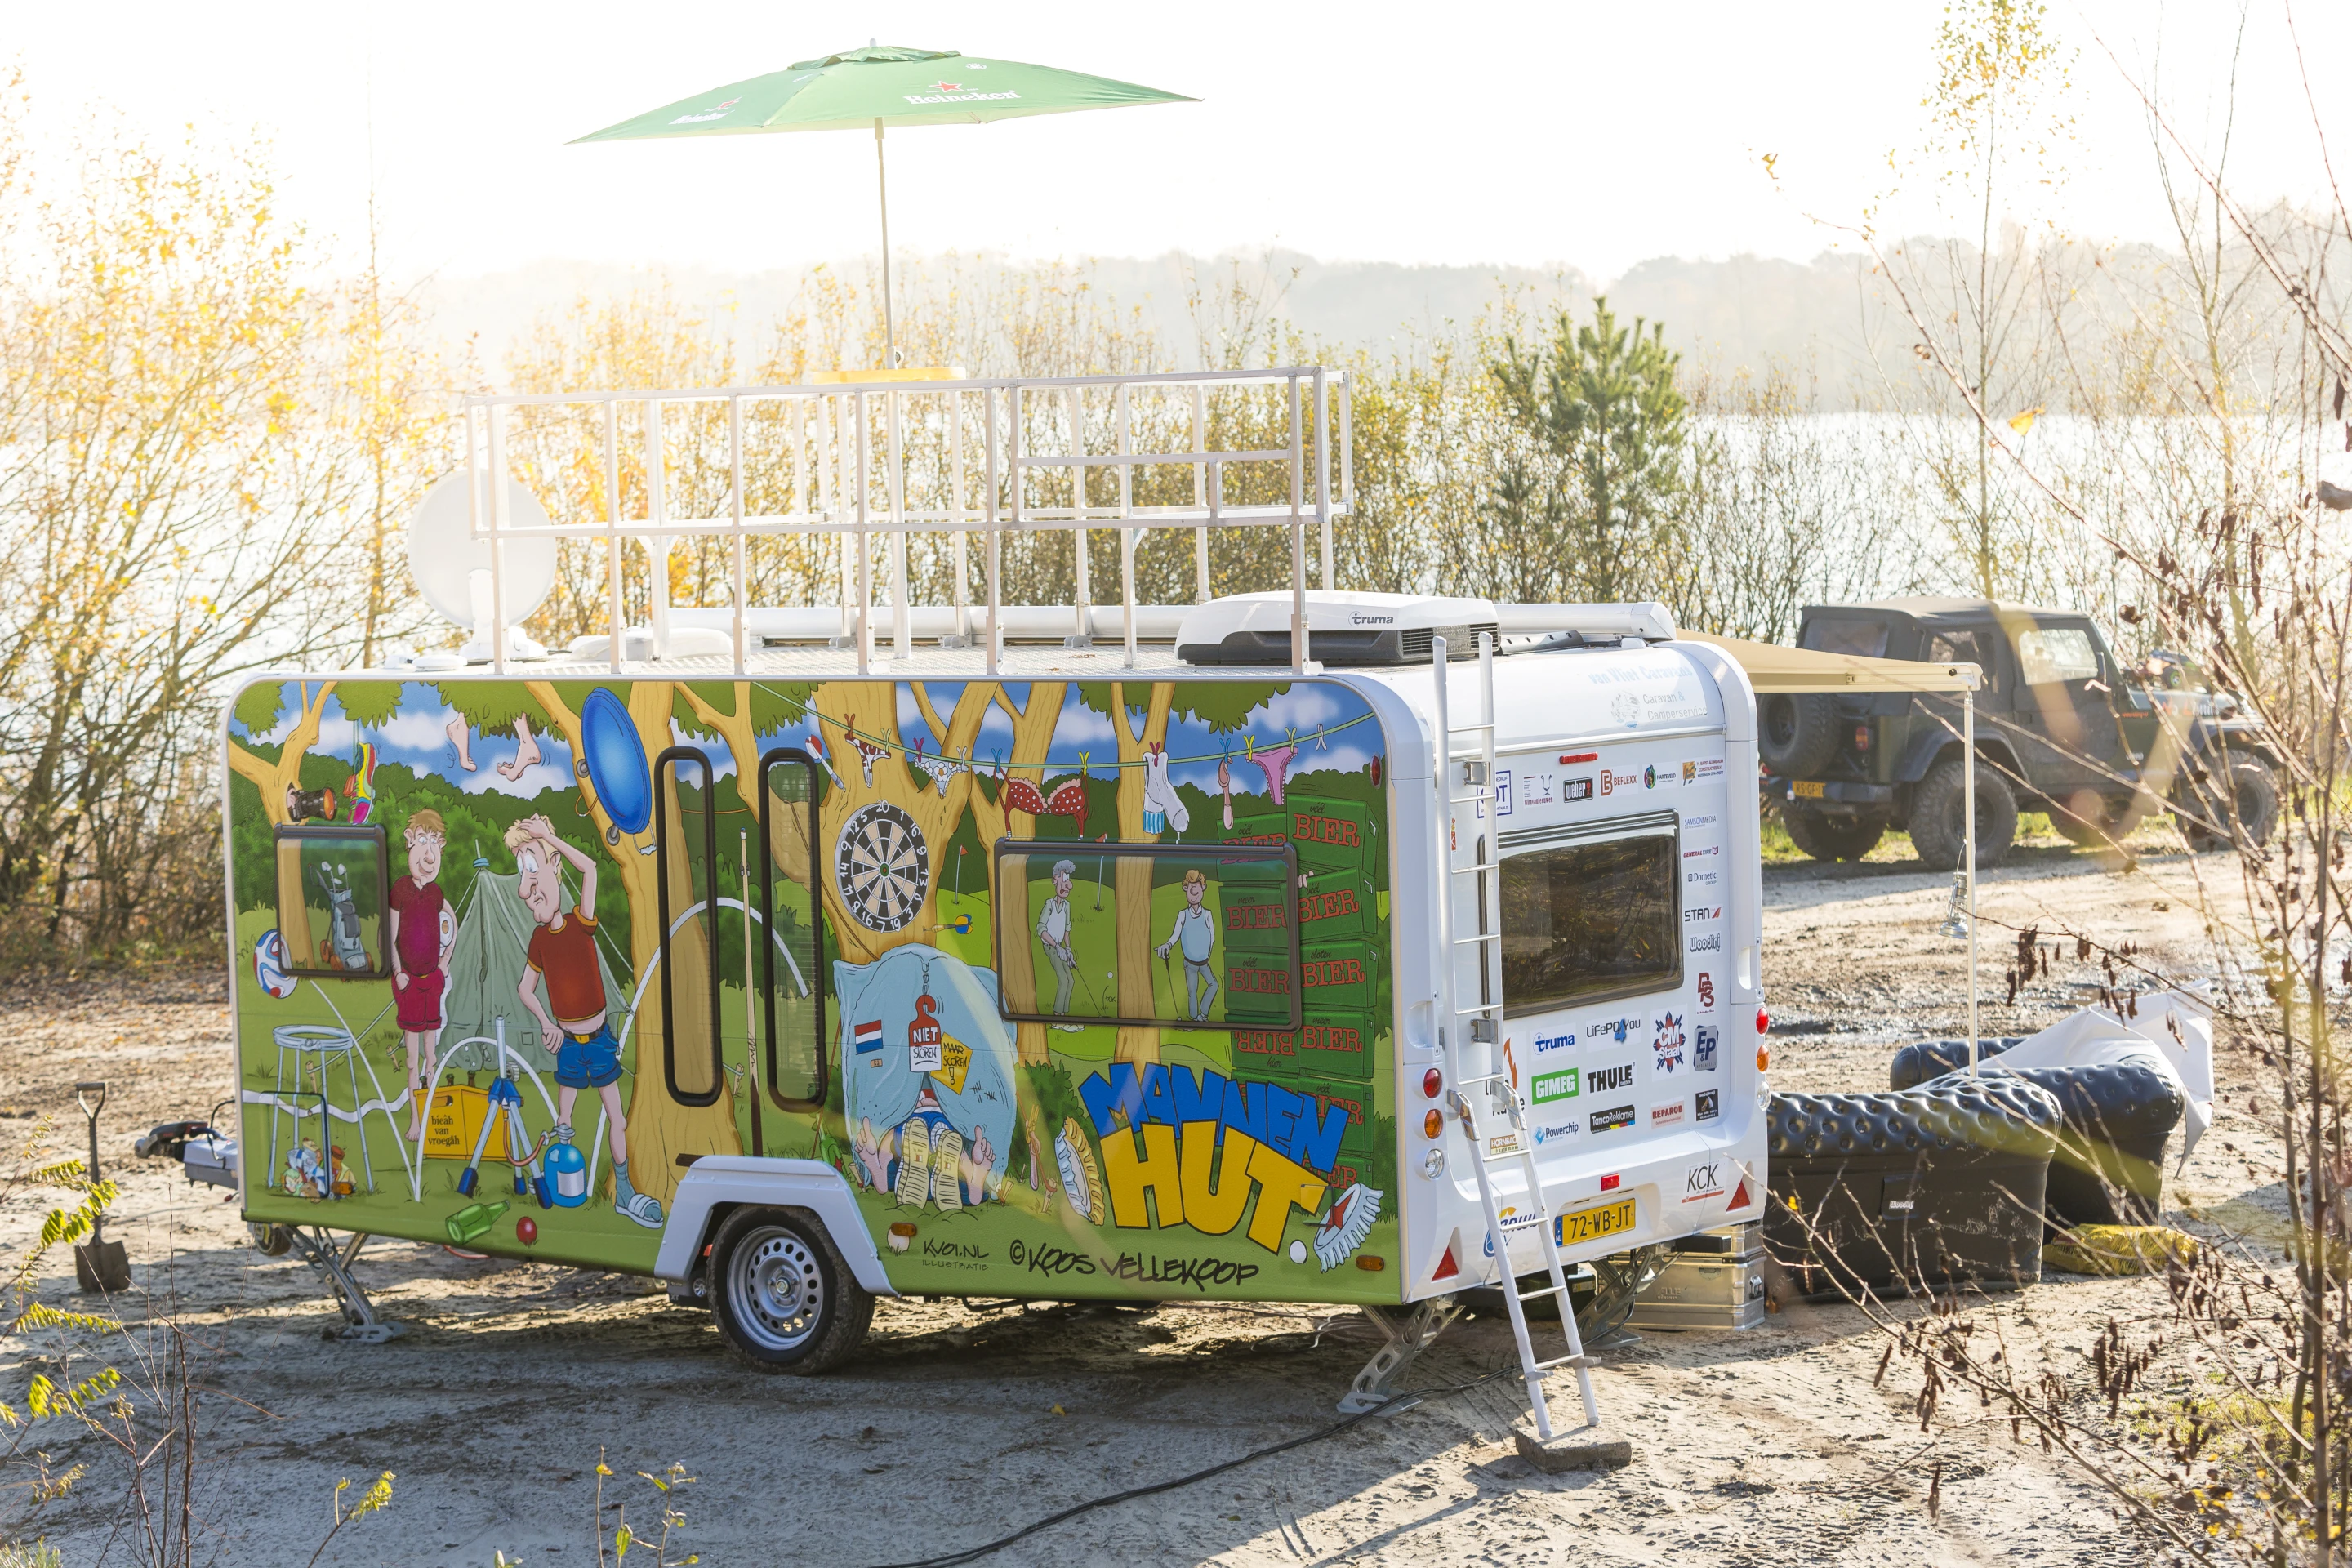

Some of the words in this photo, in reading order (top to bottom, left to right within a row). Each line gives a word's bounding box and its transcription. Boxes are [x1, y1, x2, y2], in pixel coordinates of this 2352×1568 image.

[903, 90, 1022, 105] Heineken
[1351, 615, 1394, 625] truma
[1588, 671, 1611, 684] van
[1606, 666, 1641, 683] Vliet
[1638, 665, 1693, 679] Caravans
[1642, 692, 1677, 705] Caravan
[1677, 690, 1685, 702] &
[1647, 706, 1708, 722] Camperservice
[1614, 774, 1637, 786] BEFLEXX
[1565, 781, 1586, 799] weber
[875, 800, 889, 813] 20
[900, 809, 905, 821] 1
[1684, 815, 1717, 826] SAMSONMEDIA
[848, 822, 860, 835] 12
[1293, 813, 1360, 848] BIER
[1683, 849, 1703, 858] GENERAL
[1694, 871, 1717, 882] Dometic
[1298, 889, 1360, 923] BIER
[862, 911, 873, 927] 16
[1226, 904, 1287, 930] BIER
[1684, 907, 1710, 922] STAN
[876, 920, 885, 933] 7
[890, 917, 901, 932] 19
[1300, 958, 1365, 987] BIER
[1228, 967, 1290, 995] BIER
[912, 1027, 938, 1044] NIET
[1300, 1025, 1362, 1053] BIER
[1535, 1034, 1575, 1053] truma
[1658, 1024, 1680, 1047] CM
[913, 1045, 937, 1059] STOREN
[943, 1042, 964, 1055] MAAR
[1659, 1043, 1680, 1060] Staal
[942, 1056, 968, 1068] SCOREN
[1535, 1074, 1575, 1098] GIMEG
[1588, 1064, 1633, 1094] THULE
[1078, 1062, 1350, 1174] MANNEN
[1591, 1110, 1633, 1127] TancoReklame
[1652, 1105, 1683, 1120] REPAROB
[434, 1127, 449, 1135] van
[1545, 1121, 1579, 1138] Powerchip
[1491, 1135, 1517, 1147] HORNBAC
[1686, 1163, 1719, 1192] KCK
[1099, 1120, 1332, 1255] HUT
[1570, 1205, 1631, 1239] 72-WB-JT
[923, 1237, 990, 1258] KVOI.NL
[922, 1259, 989, 1272] ILLUSTRATIE
[1099, 1251, 1260, 1293] VELLEKOOP
